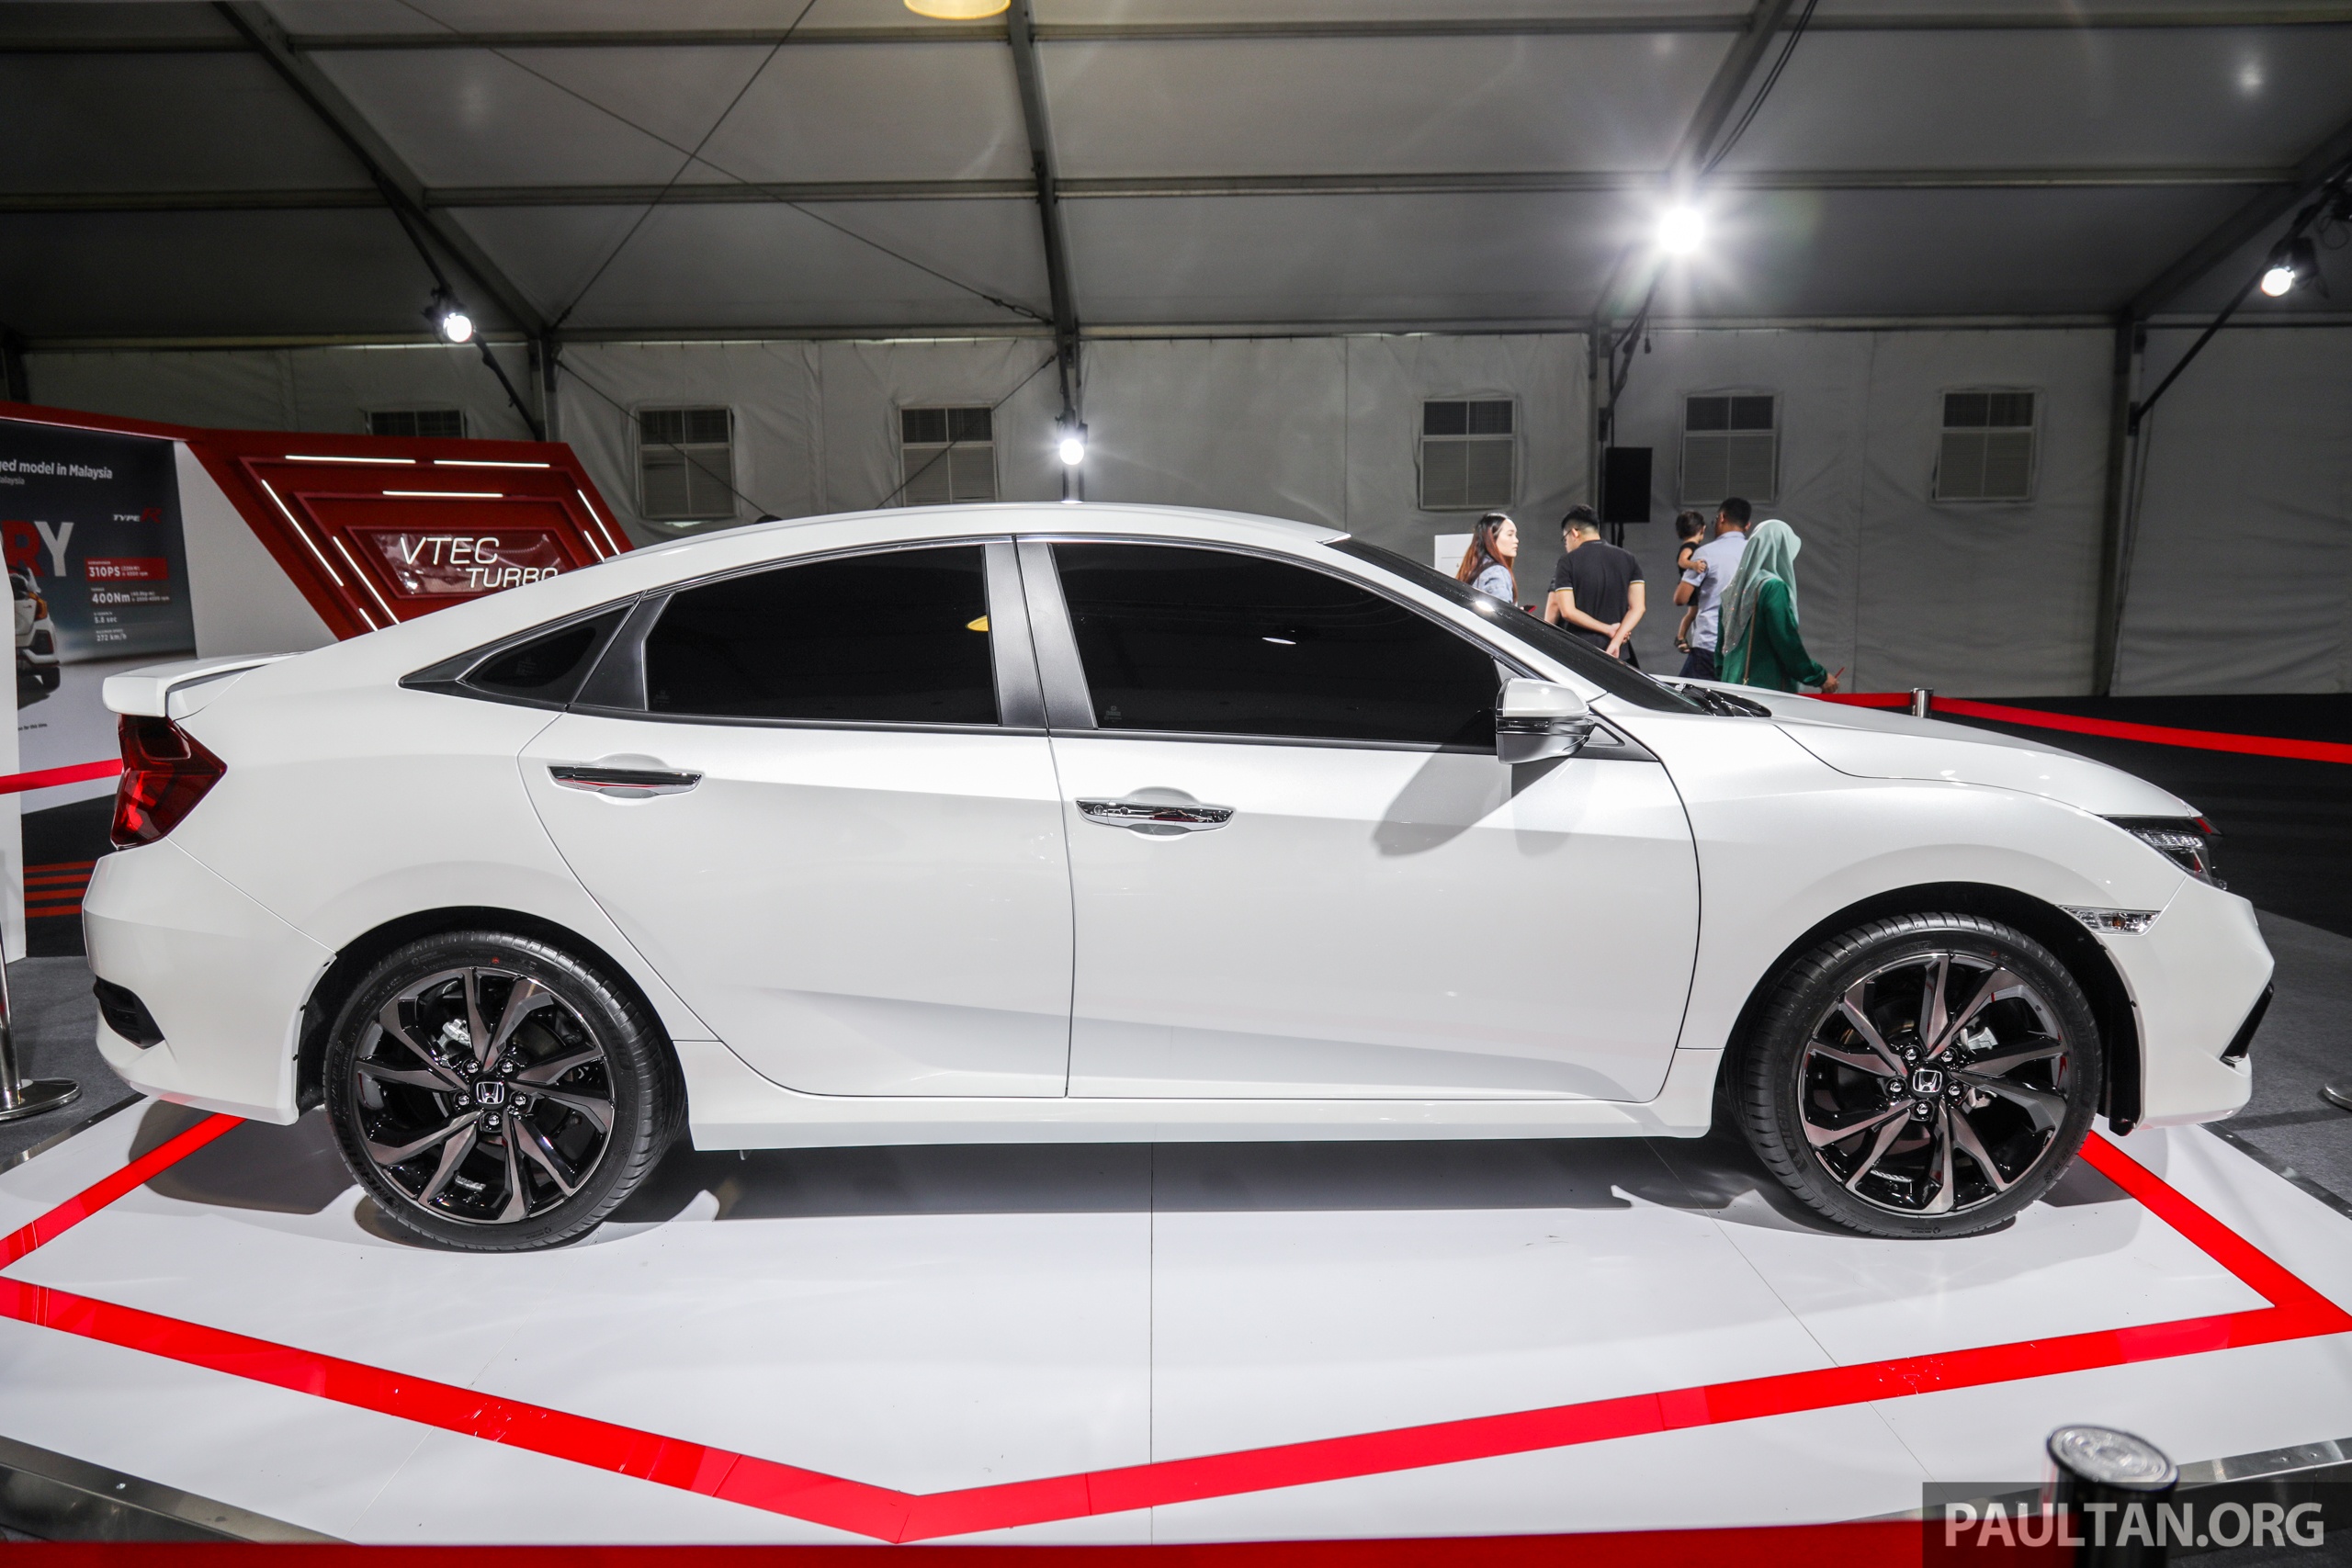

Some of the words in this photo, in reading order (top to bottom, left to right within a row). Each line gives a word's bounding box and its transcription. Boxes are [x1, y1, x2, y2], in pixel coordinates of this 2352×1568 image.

[19, 461, 54, 475] model
[57, 463, 67, 476] in
[69, 464, 113, 480] Malaysia
[400, 536, 500, 565] VTEC
[88, 567, 120, 577] 310PS
[92, 592, 130, 604] 400Nm
[96, 634, 108, 642] 272
[110, 633, 127, 641] km/h
